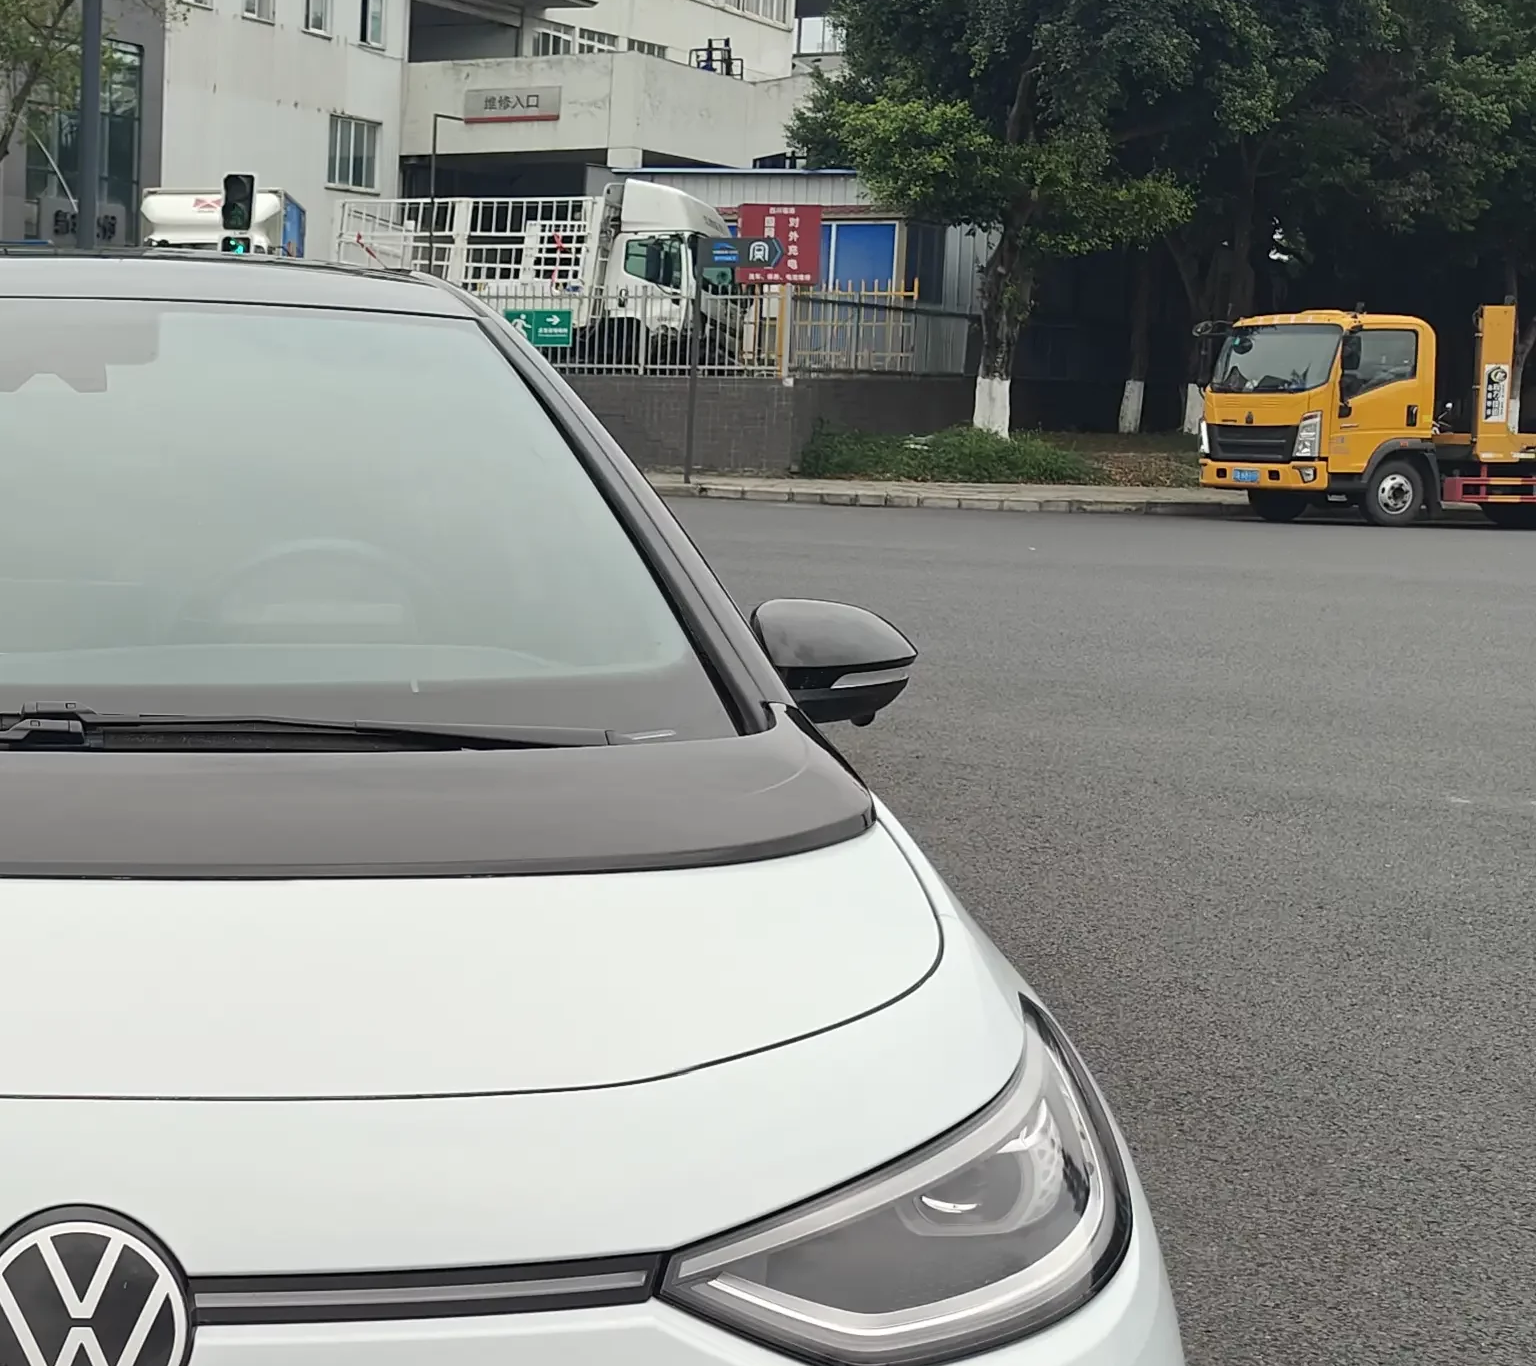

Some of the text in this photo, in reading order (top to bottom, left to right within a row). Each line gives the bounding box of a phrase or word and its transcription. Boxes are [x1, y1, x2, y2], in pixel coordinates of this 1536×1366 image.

[483, 94, 539, 110] 维修入口
[786, 216, 800, 270] 对外充电
